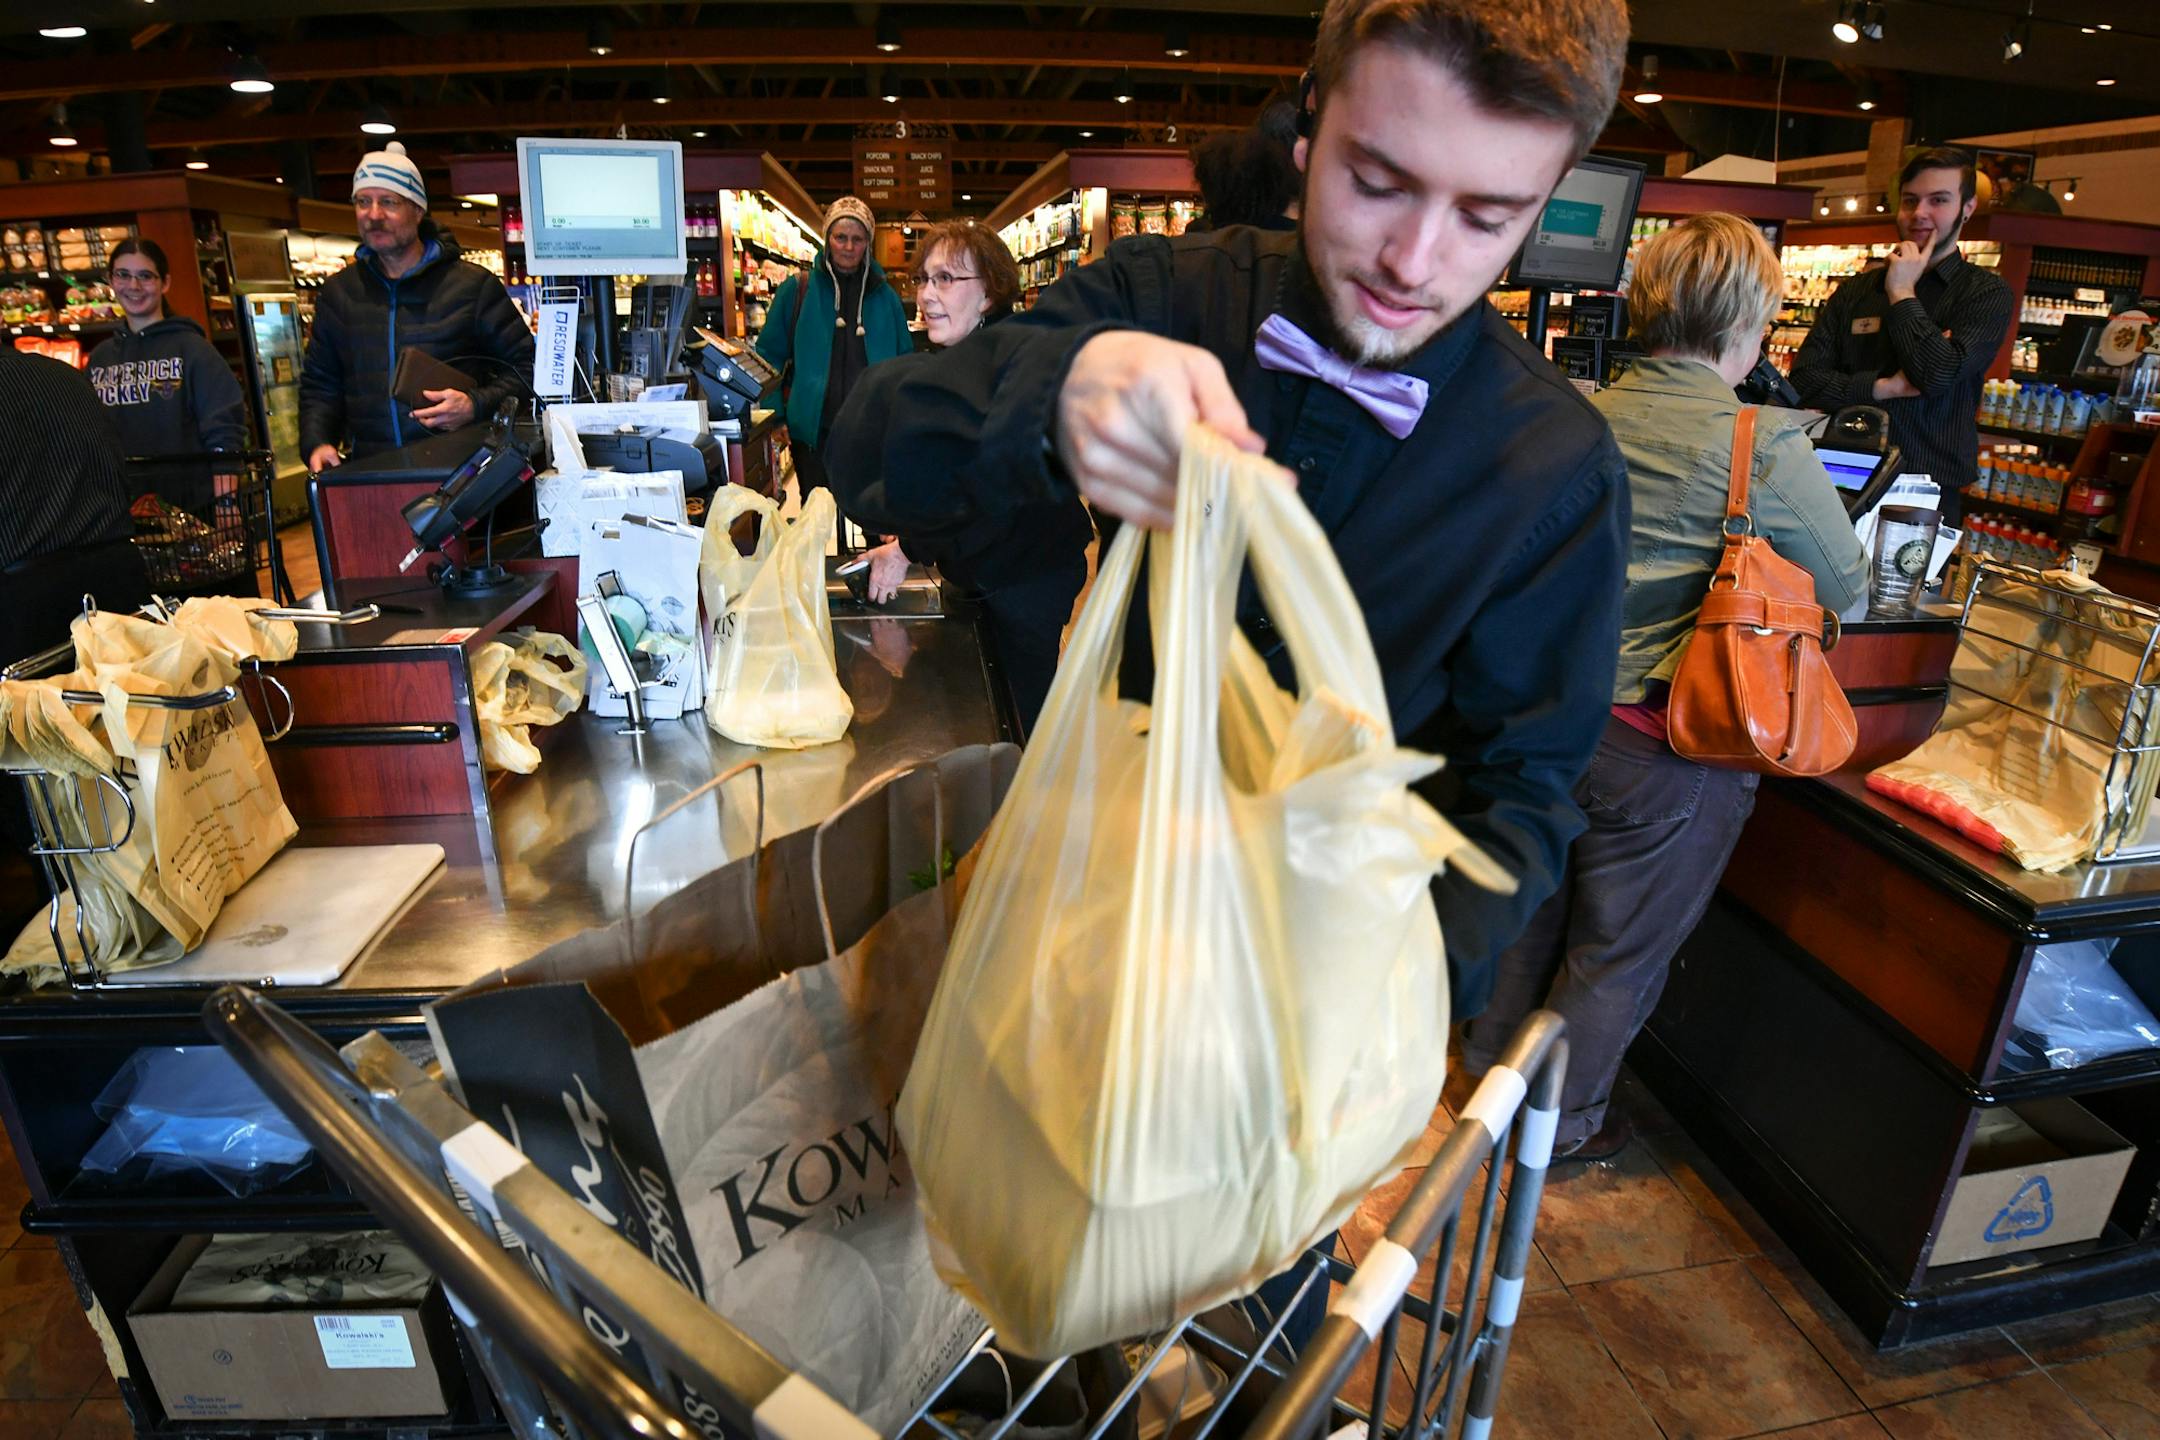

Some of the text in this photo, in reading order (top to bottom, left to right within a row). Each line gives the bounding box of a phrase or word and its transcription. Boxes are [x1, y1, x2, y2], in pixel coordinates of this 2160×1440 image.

[616, 123, 628, 140] 4
[895, 120, 907, 139] 3
[1167, 125, 1177, 143] 2
[865, 152, 890, 160] POPCORN
[710, 1092, 901, 1269] KOW
[336, 1331, 384, 1340] Kowalski's
